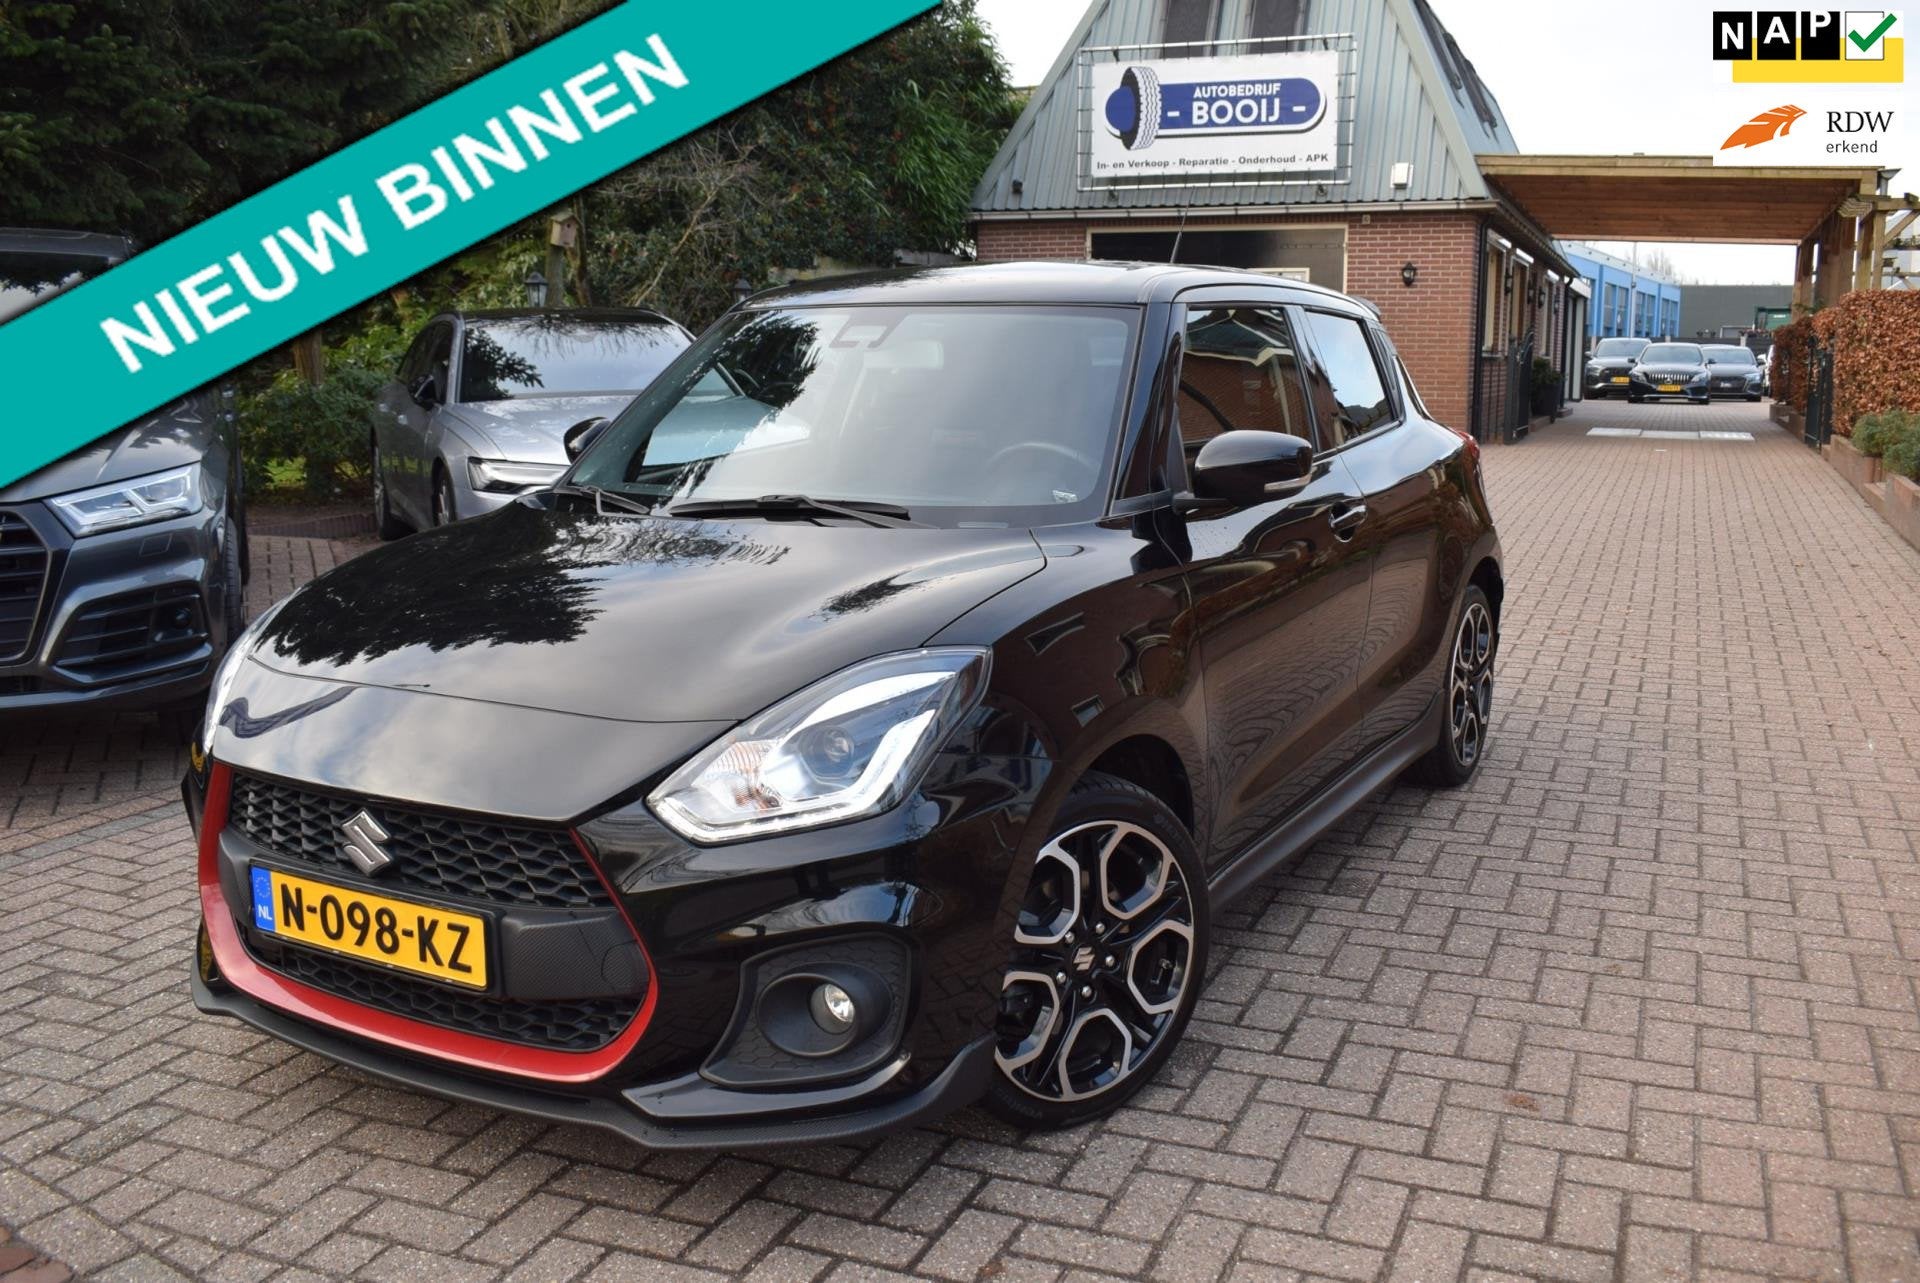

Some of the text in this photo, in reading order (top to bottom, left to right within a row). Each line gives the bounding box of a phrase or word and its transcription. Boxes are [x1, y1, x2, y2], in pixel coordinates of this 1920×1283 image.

[1193, 82, 1281, 98] AUTOBEDRIJF
[1192, 98, 1280, 125] BOOIJ
[1096, 161, 1110, 169] In-
[1128, 158, 1170, 169] Verkoop
[1178, 156, 1229, 167] Reparatie
[1238, 154, 1296, 165] Onderhoud
[1305, 153, 1329, 162] APK
[257, 902, 273, 922] NL
[280, 883, 472, 974] N-098-KZ
